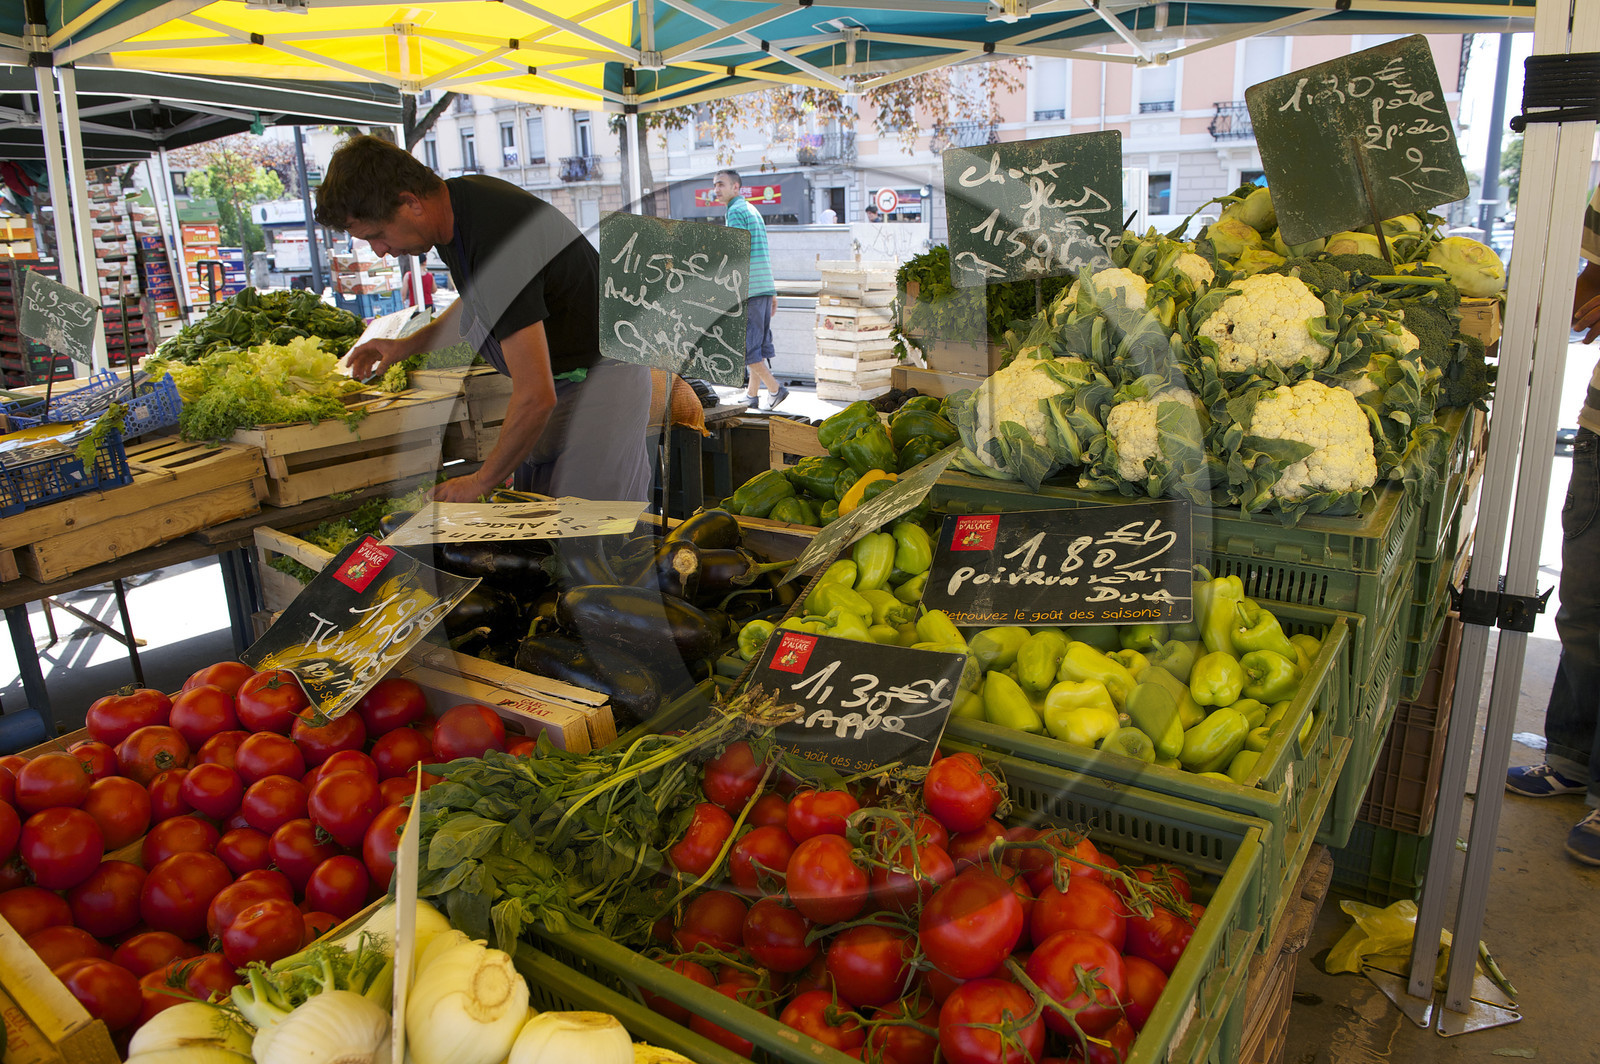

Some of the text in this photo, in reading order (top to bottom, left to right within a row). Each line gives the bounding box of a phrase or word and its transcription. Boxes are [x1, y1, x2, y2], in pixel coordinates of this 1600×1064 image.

[959, 522, 992, 531] D'ALSACE
[358, 547, 385, 565] D'ALSACE
[1014, 608, 1025, 620] le
[1029, 605, 1064, 622] goût
[1069, 608, 1095, 620] des
[1101, 607, 1161, 619] saisons
[782, 640, 809, 651] D'ALSACE
[791, 744, 800, 756] le
[804, 748, 829, 763] goût
[831, 755, 851, 767] des
